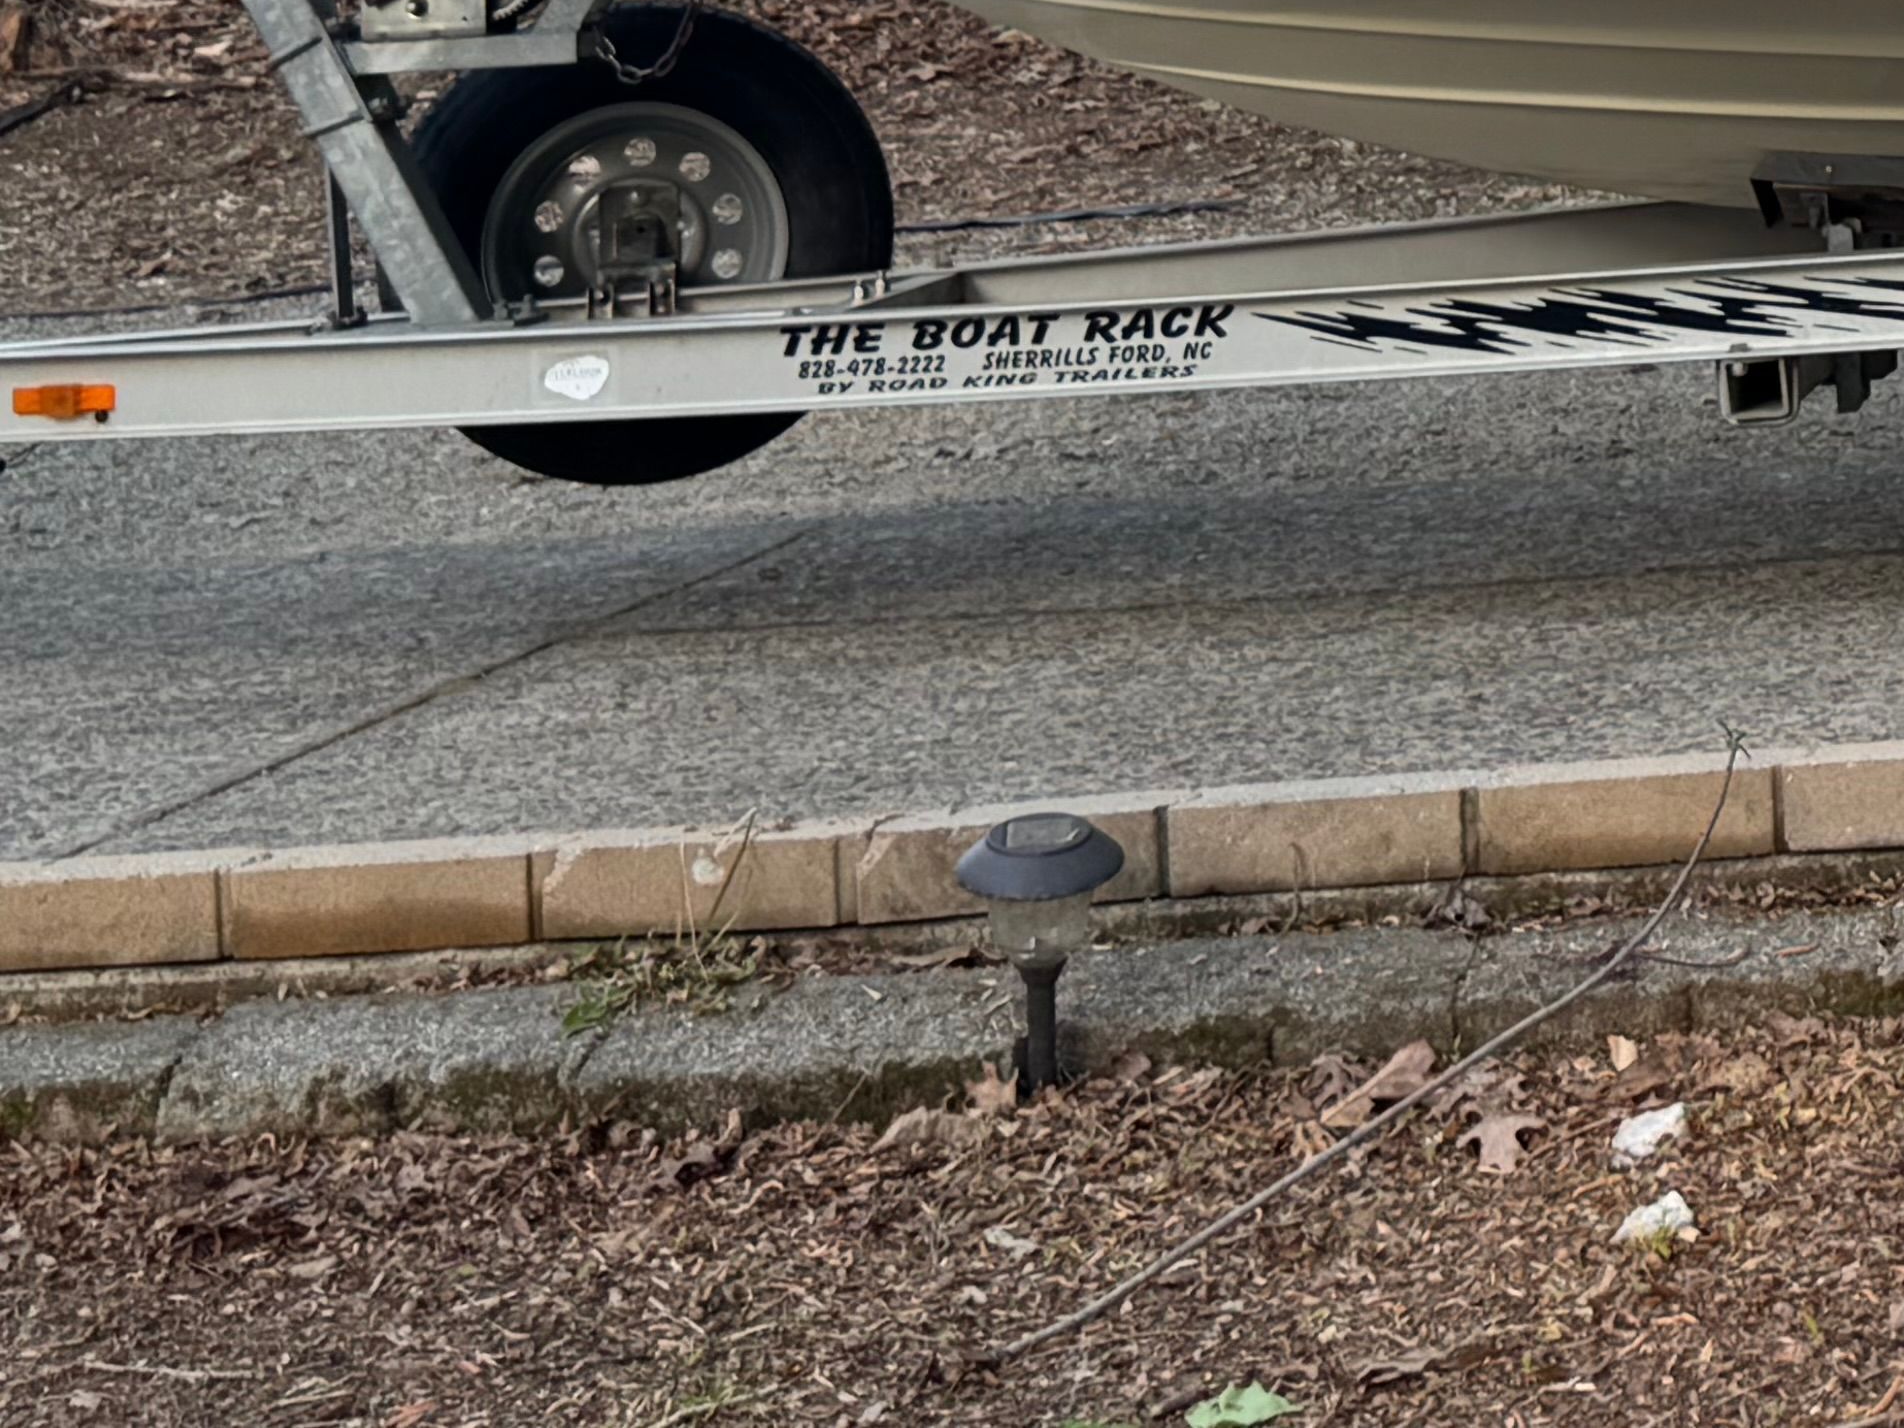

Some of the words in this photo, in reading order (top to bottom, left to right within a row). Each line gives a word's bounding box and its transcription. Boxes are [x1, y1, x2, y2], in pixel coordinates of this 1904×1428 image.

[780, 321, 885, 357] THE
[912, 311, 1061, 350] BOAT
[1083, 303, 1235, 344] RACK
[798, 354, 946, 379] 828-478-2222
[982, 346, 1100, 371] SHERRILLS
[1108, 342, 1172, 365] FORD,
[1182, 341, 1213, 361] NC
[817, 380, 854, 395] BY
[868, 376, 949, 393] ROAD
[962, 371, 1039, 389] KING
[1054, 363, 1198, 384] TRAILERS
